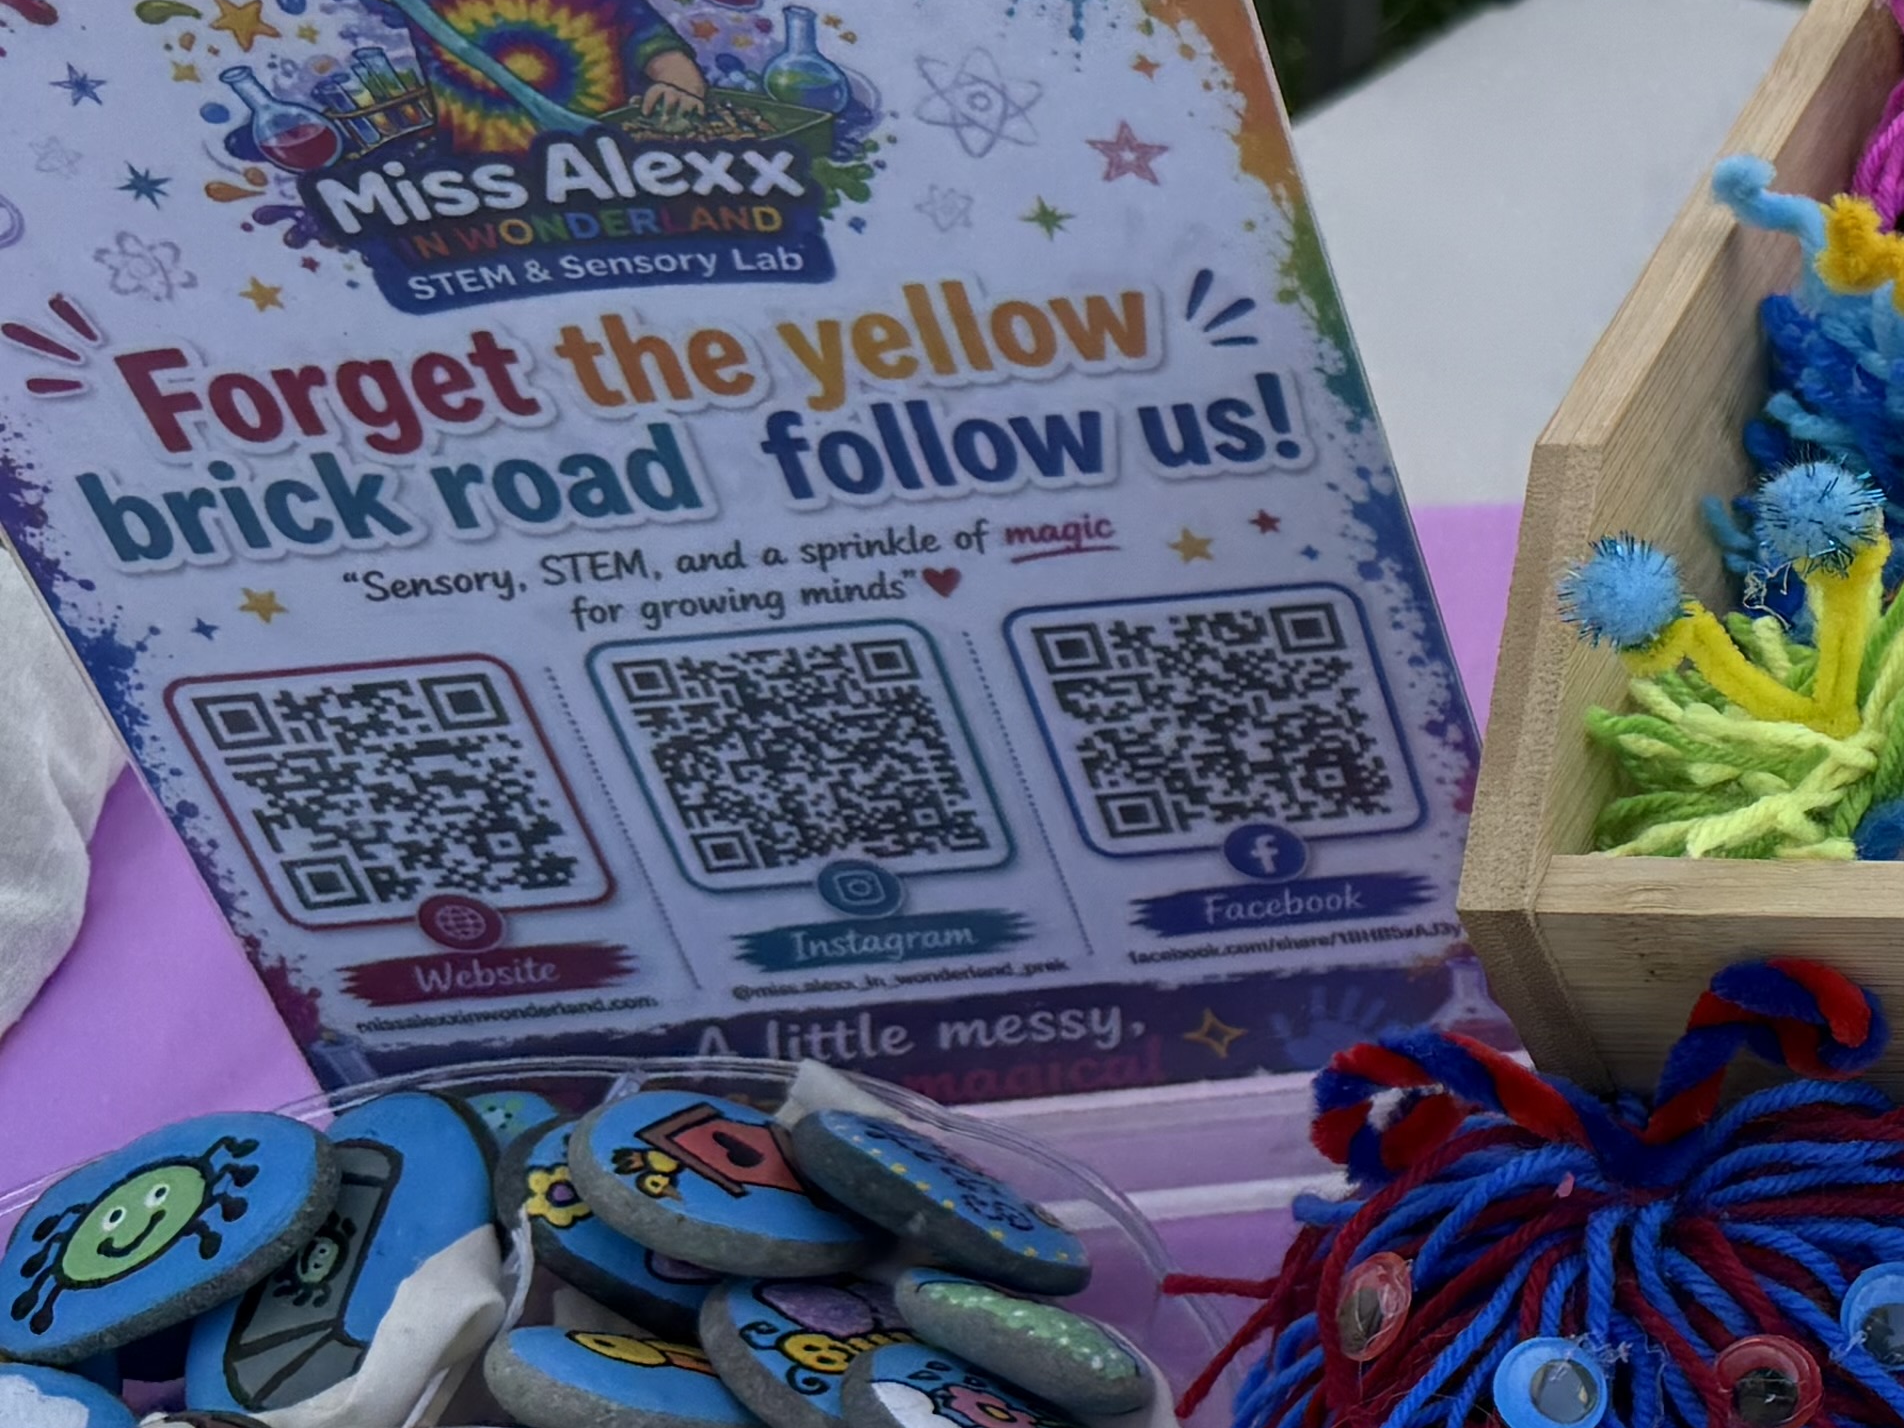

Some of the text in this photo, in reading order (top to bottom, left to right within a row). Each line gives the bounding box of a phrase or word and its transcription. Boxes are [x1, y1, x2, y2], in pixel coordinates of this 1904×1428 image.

[316, 137, 806, 233] Miss Alexx
[459, 205, 782, 252] WONDERLAND
[408, 245, 804, 300] STEM & Sensory Lab
[114, 280, 1148, 455] Forget the yellow
[76, 373, 1303, 563] brick road follow us!
[539, 551, 663, 586] STEM,
[676, 543, 746, 571] and
[762, 547, 789, 568] a
[801, 525, 940, 566] sprinkle
[956, 519, 990, 552] of
[1005, 514, 1115, 551] magic
[571, 594, 623, 631] for
[641, 588, 787, 627] growing
[1205, 884, 1366, 924] Facebook
[790, 927, 979, 963] Instagram
[415, 958, 556, 992] Website
[700, 1006, 1146, 1061] A little messy,
